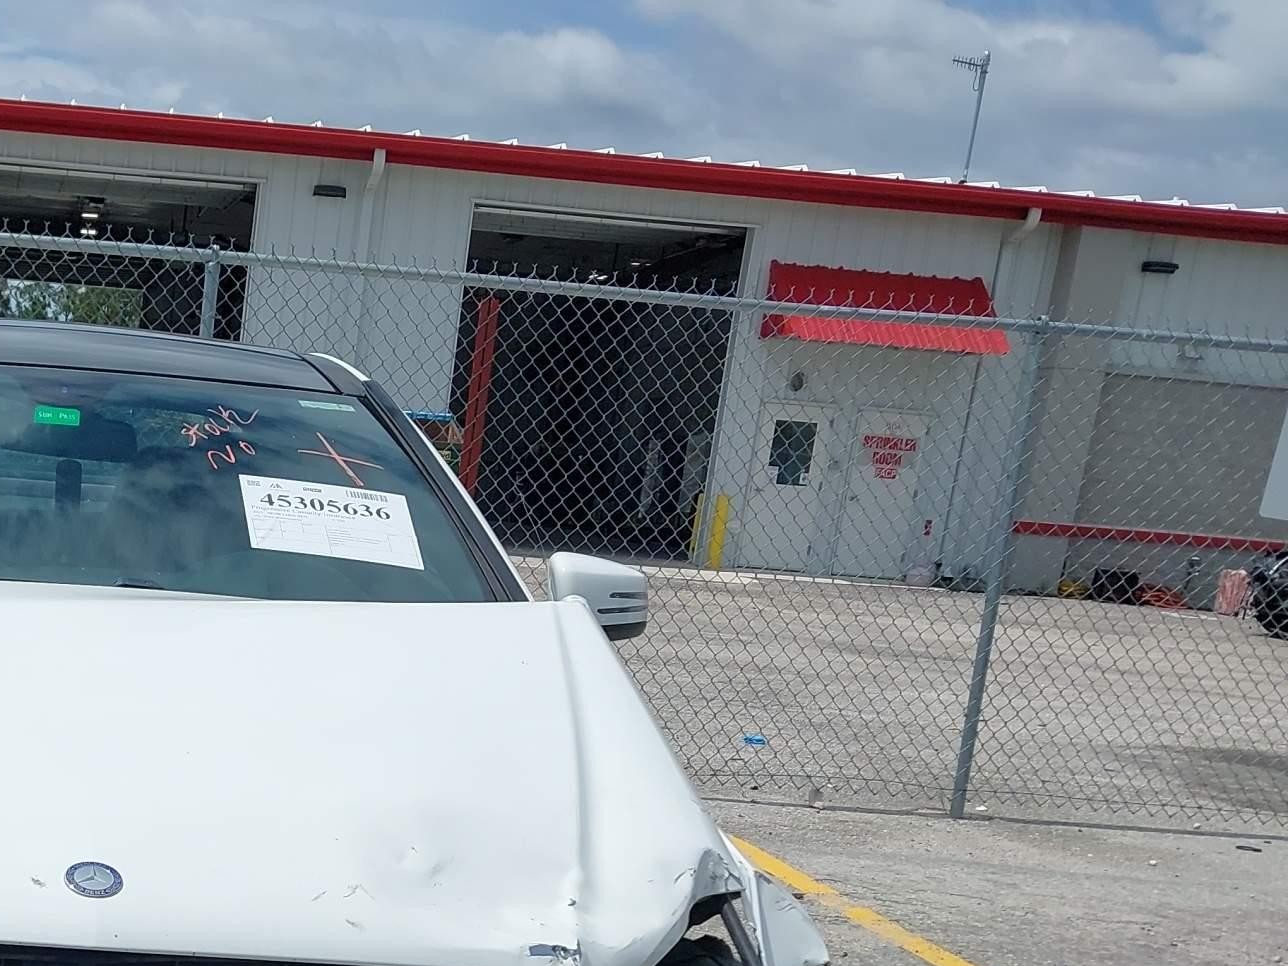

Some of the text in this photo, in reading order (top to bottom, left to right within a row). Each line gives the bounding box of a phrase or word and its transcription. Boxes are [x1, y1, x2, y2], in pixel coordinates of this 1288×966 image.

[863, 435, 917, 452] SPRINKLER
[872, 451, 902, 466] ROOM
[259, 492, 391, 520] 45305636
